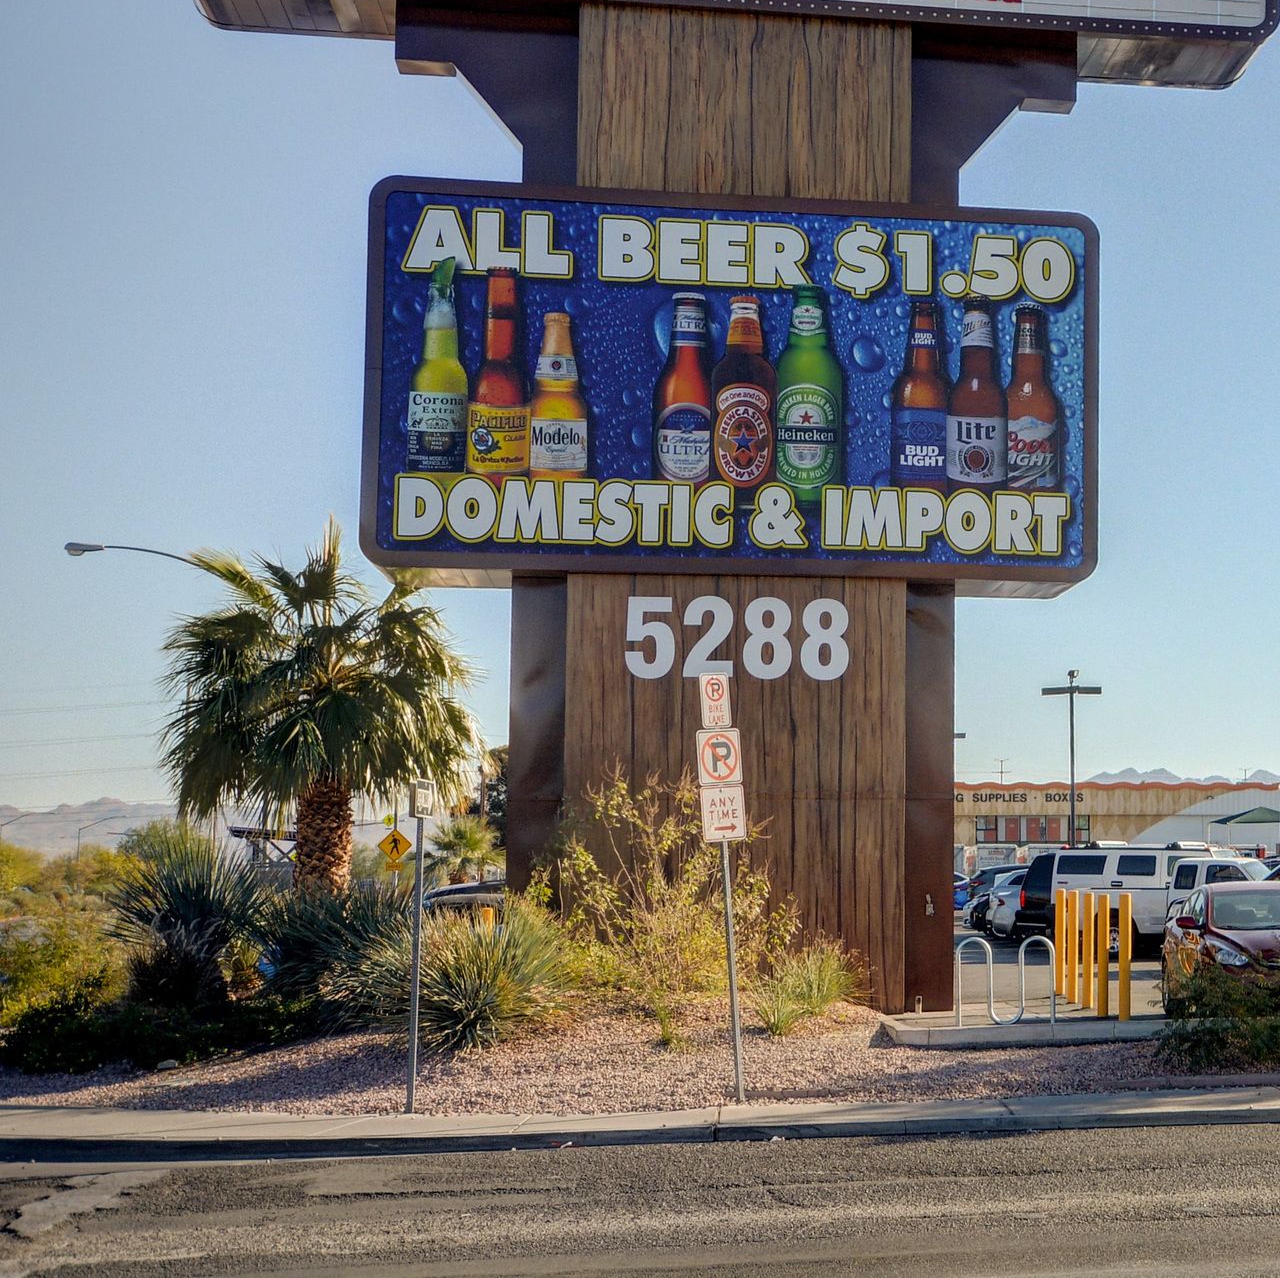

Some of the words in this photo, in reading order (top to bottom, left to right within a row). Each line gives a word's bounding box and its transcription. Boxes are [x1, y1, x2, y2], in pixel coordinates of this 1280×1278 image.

[403, 206, 573, 278] ALL
[598, 214, 812, 288] BEER
[833, 224, 1074, 302] $1.50
[911, 338, 936, 346] LIGHT
[914, 332, 933, 340] BUD
[412, 393, 464, 406] Corona
[803, 393, 825, 407] LAGER
[422, 406, 455, 414] Extra
[721, 408, 767, 436] NEWCASTLE
[531, 425, 580, 446] Modelo
[778, 428, 834, 442] Heineken
[955, 420, 996, 444] Lite
[905, 445, 940, 456] BUD
[720, 453, 755, 480] BROWN
[754, 452, 767, 475] ALE
[900, 455, 945, 467] LIGHT
[1008, 453, 1054, 467] IGHT
[395, 477, 736, 549] DOMESTIC
[749, 490, 808, 549] &
[822, 485, 1071, 557] IMPORT
[624, 595, 850, 681] 5288
[708, 704, 724, 714] BIKE
[708, 714, 725, 723] LANE
[709, 796, 736, 809] ANY
[972, 793, 1027, 802] SUPPLIES
[1045, 793, 1084, 802] BOXS
[709, 808, 738, 821] TIME
